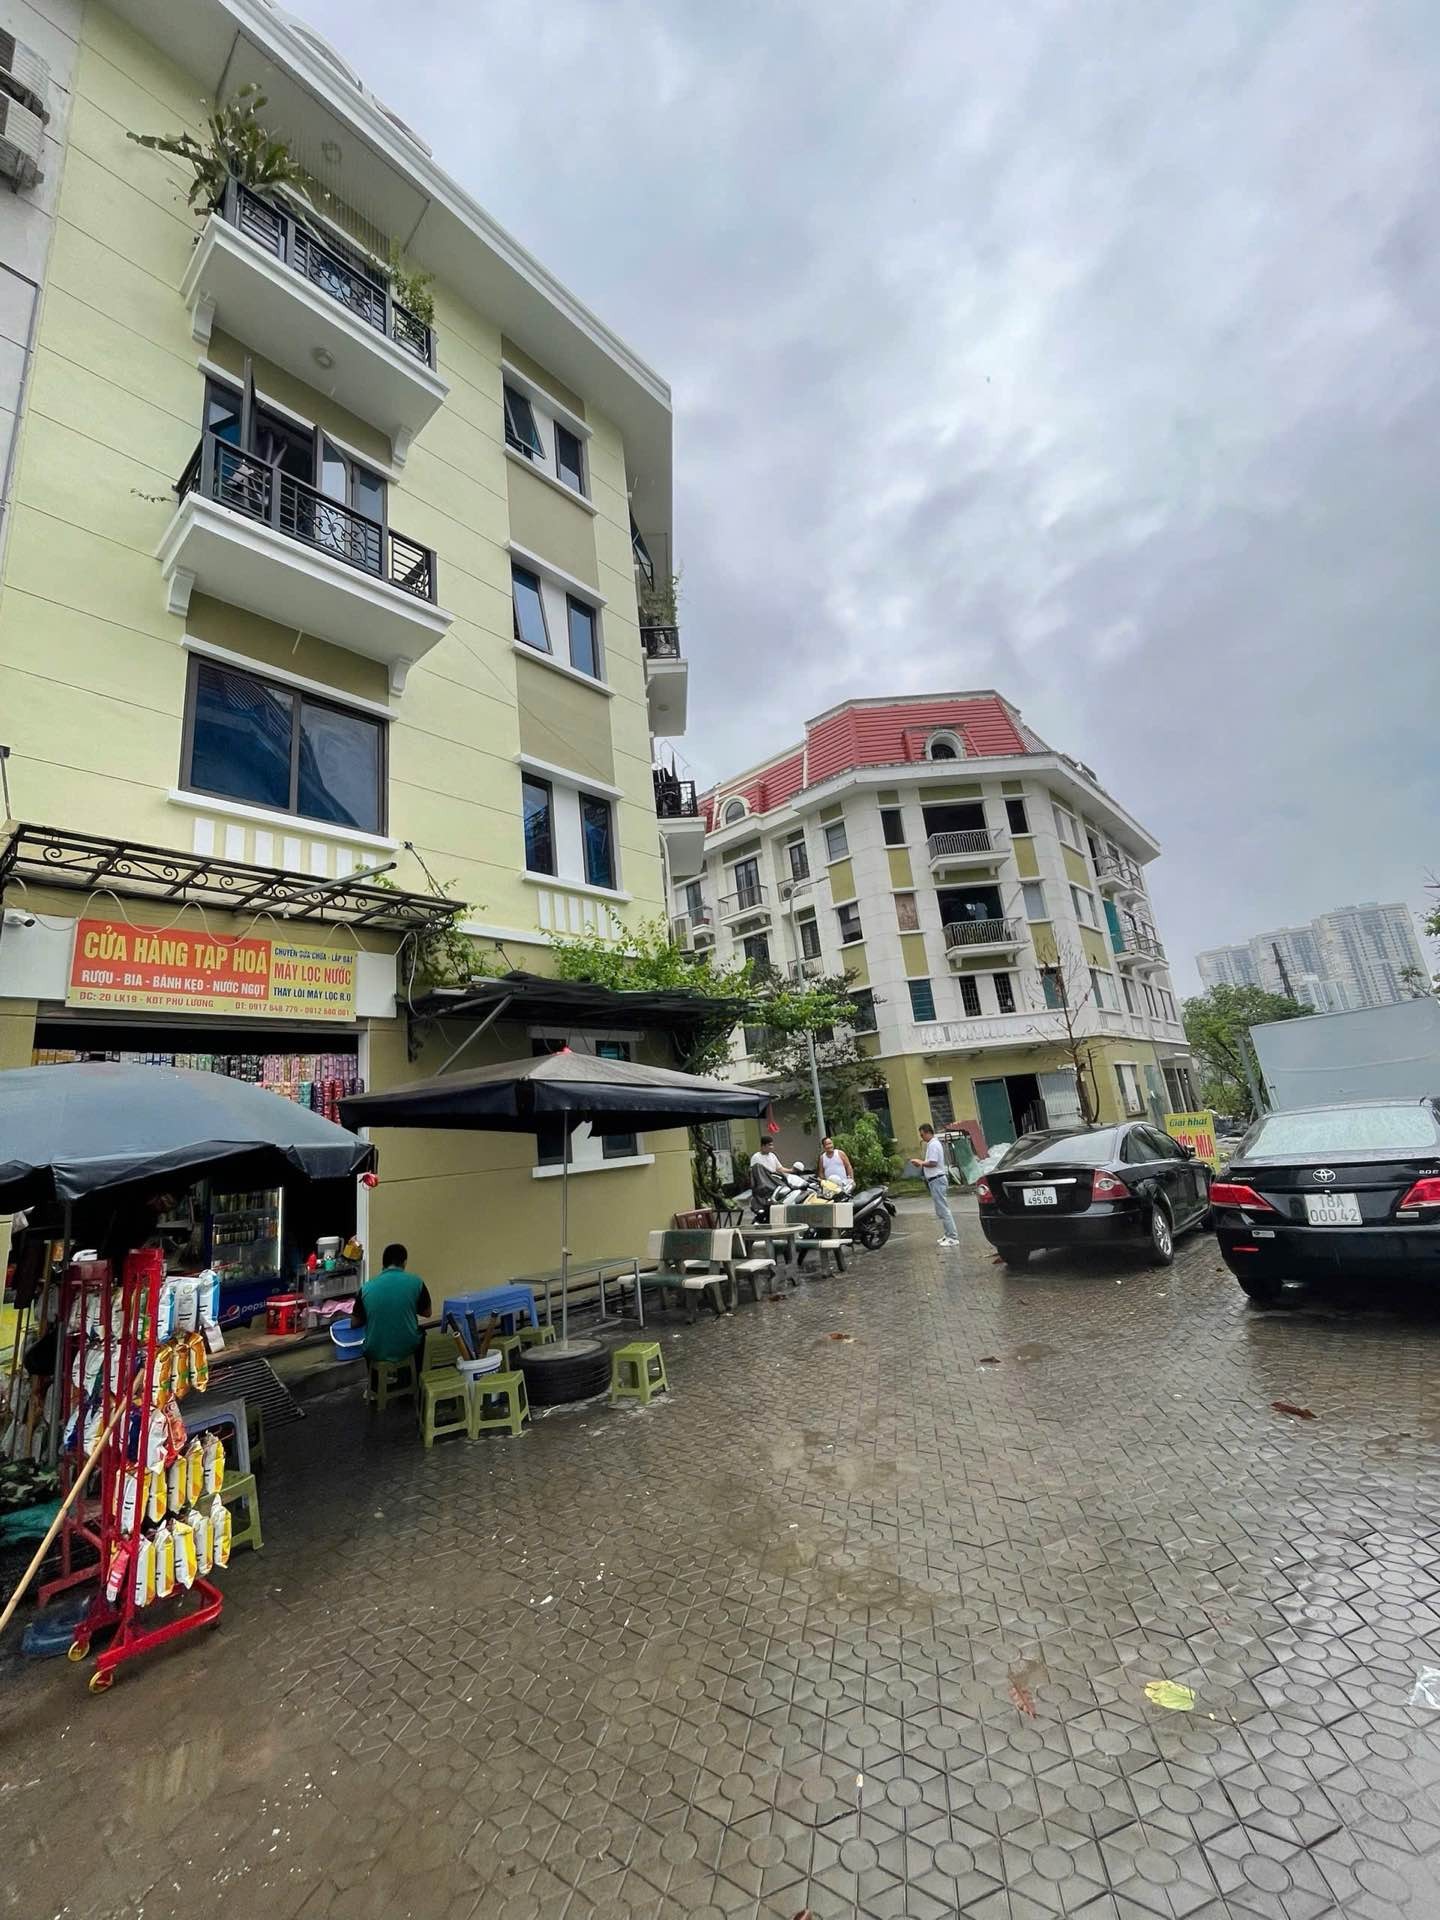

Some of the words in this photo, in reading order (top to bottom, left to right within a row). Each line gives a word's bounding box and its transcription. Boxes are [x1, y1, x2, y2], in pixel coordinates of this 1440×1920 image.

[84, 925, 127, 961] CỬA
[134, 934, 188, 967] HÀNG
[194, 944, 228, 975] TẠP
[233, 946, 268, 975] HOÁ
[81, 969, 113, 987] RƯỢU
[123, 973, 143, 987] BIA
[152, 973, 182, 991] BÁNH
[184, 977, 204, 993] KẸO
[212, 977, 239, 994] NƯỚC
[241, 983, 266, 997] NGỌT
[274, 960, 297, 981] MÁY
[302, 965, 321, 986] LỌC
[324, 966, 351, 985] NƯỚC
[273, 986, 292, 998] THAY
